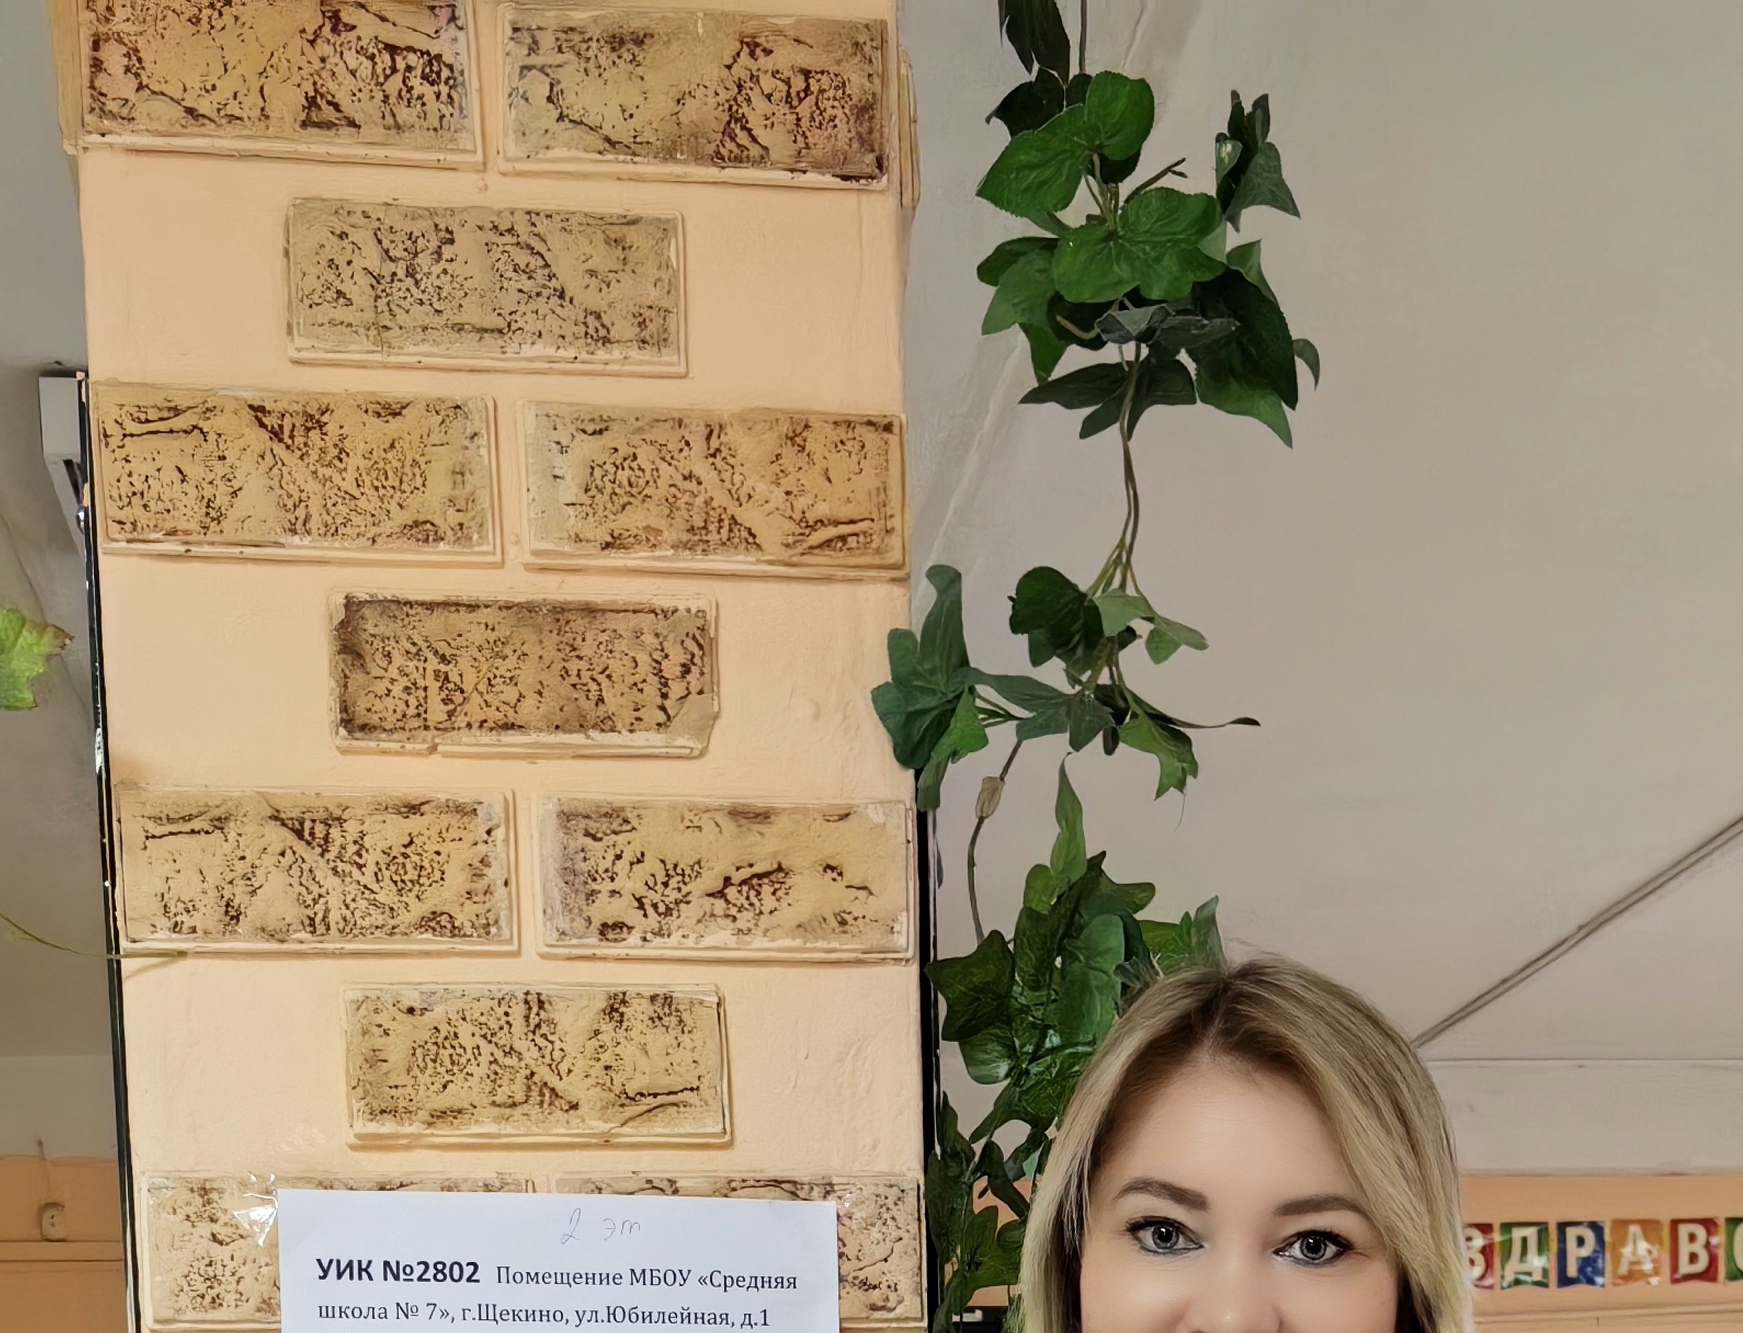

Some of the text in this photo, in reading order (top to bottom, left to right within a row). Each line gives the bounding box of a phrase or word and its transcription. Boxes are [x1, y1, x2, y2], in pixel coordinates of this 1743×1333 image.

[559, 1207, 641, 1246] 2 эт
[315, 1257, 798, 1294] УИК №2802 Помещение МБОУ «Средняя
[317, 1301, 771, 1330] школа № 7», г.Щекино, ул.Юбилейная, д.1
